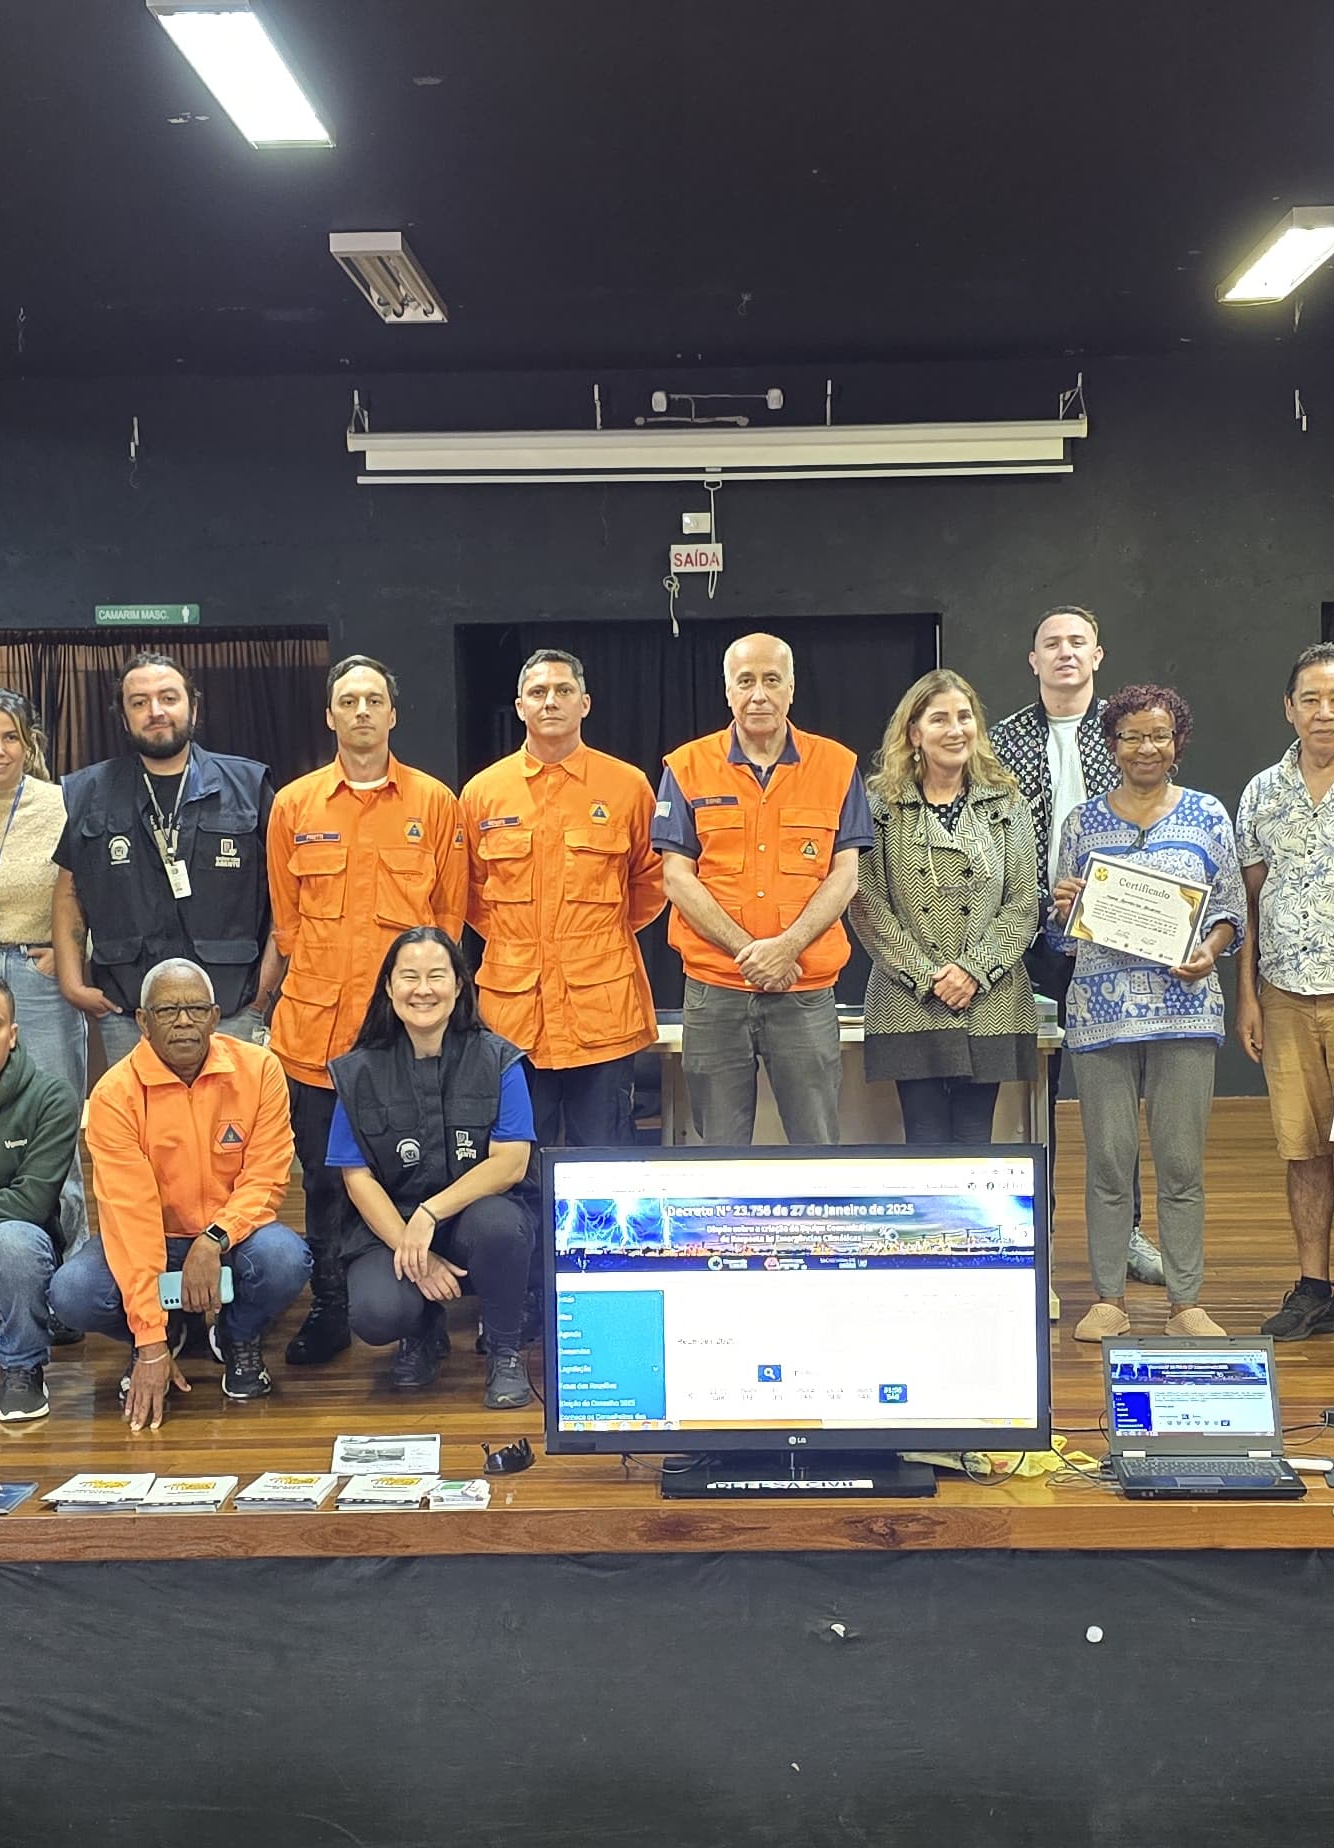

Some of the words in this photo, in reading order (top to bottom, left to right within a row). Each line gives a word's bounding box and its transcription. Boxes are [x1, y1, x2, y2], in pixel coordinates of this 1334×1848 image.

[673, 549, 720, 567] SAÍDA
[98, 609, 140, 620] CAMARIM
[141, 609, 170, 620] MASC.
[1119, 877, 1171, 900] Certificado
[773, 1204, 788, 1216] de
[806, 1203, 821, 1216] de
[868, 1203, 885, 1216] de
[885, 1203, 915, 1216] 2025
[716, 1481, 801, 1489] DEFESA
